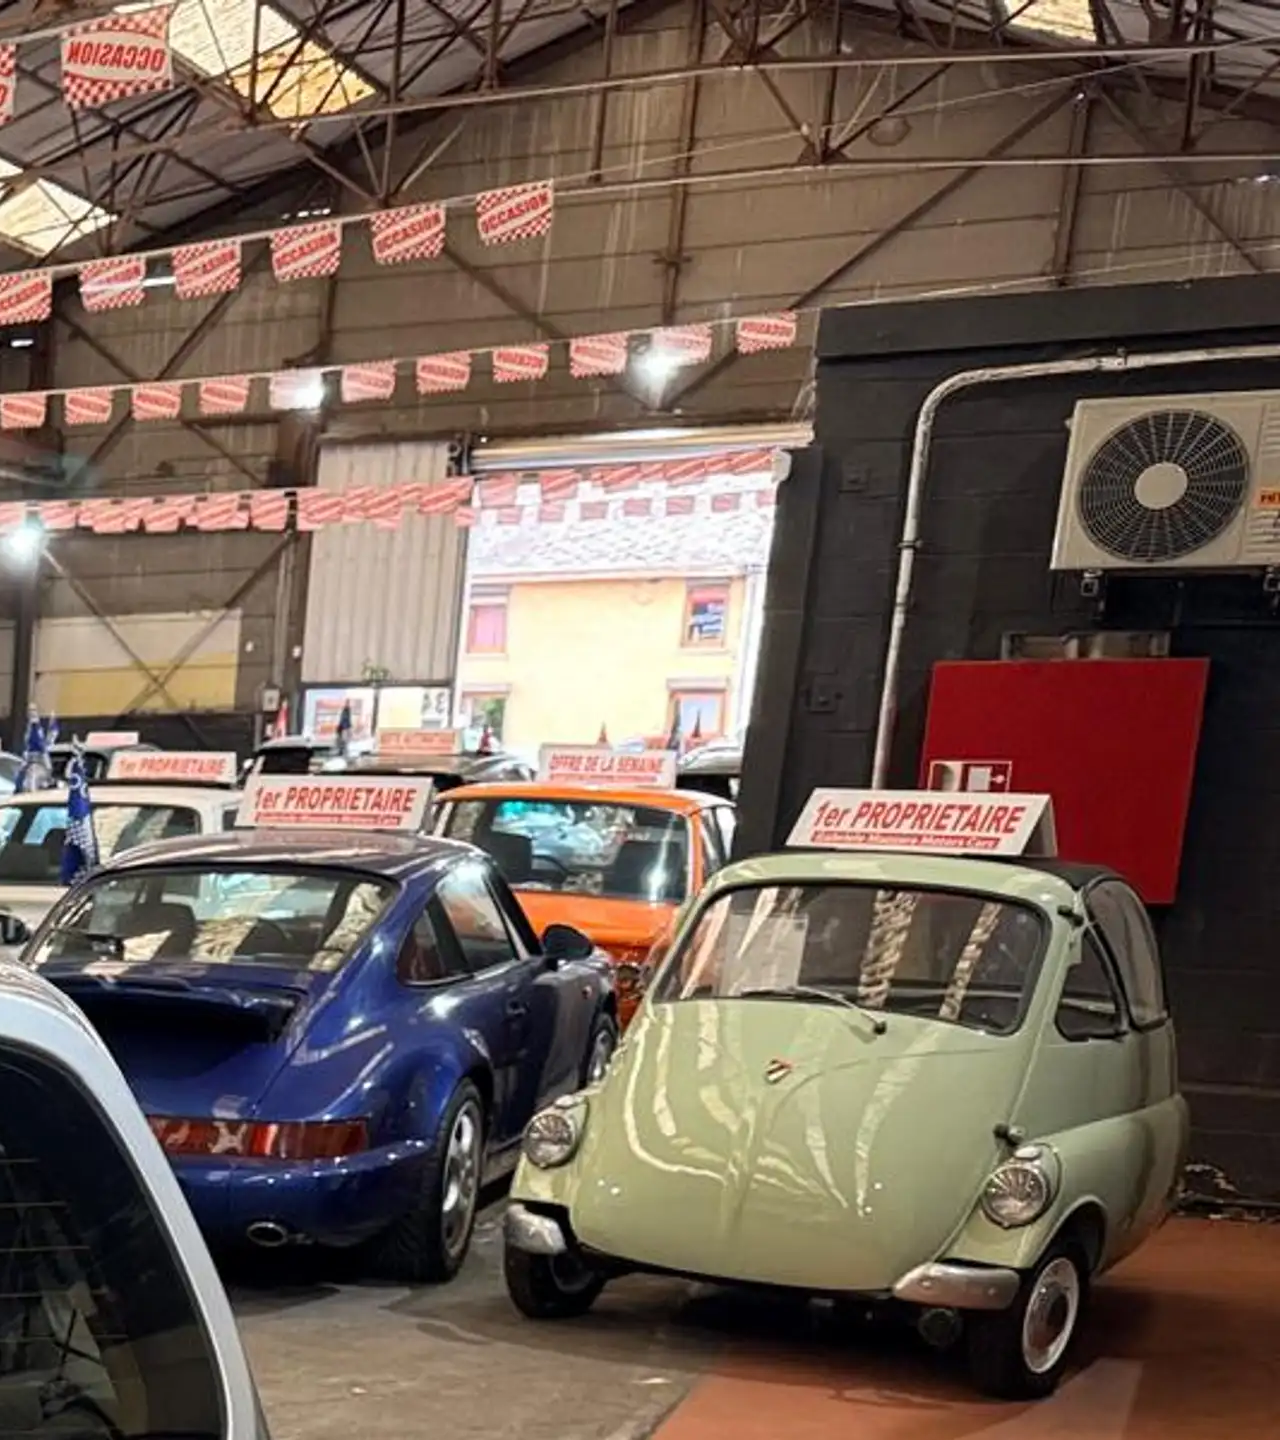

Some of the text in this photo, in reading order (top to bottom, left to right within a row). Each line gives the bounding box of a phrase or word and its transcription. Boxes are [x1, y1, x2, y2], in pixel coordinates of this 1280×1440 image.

[481, 192, 549, 234] OCCASION
[254, 786, 419, 812] 1er PROPRIETAIRE
[811, 800, 1027, 834] 1er PROPRIETAIRE
